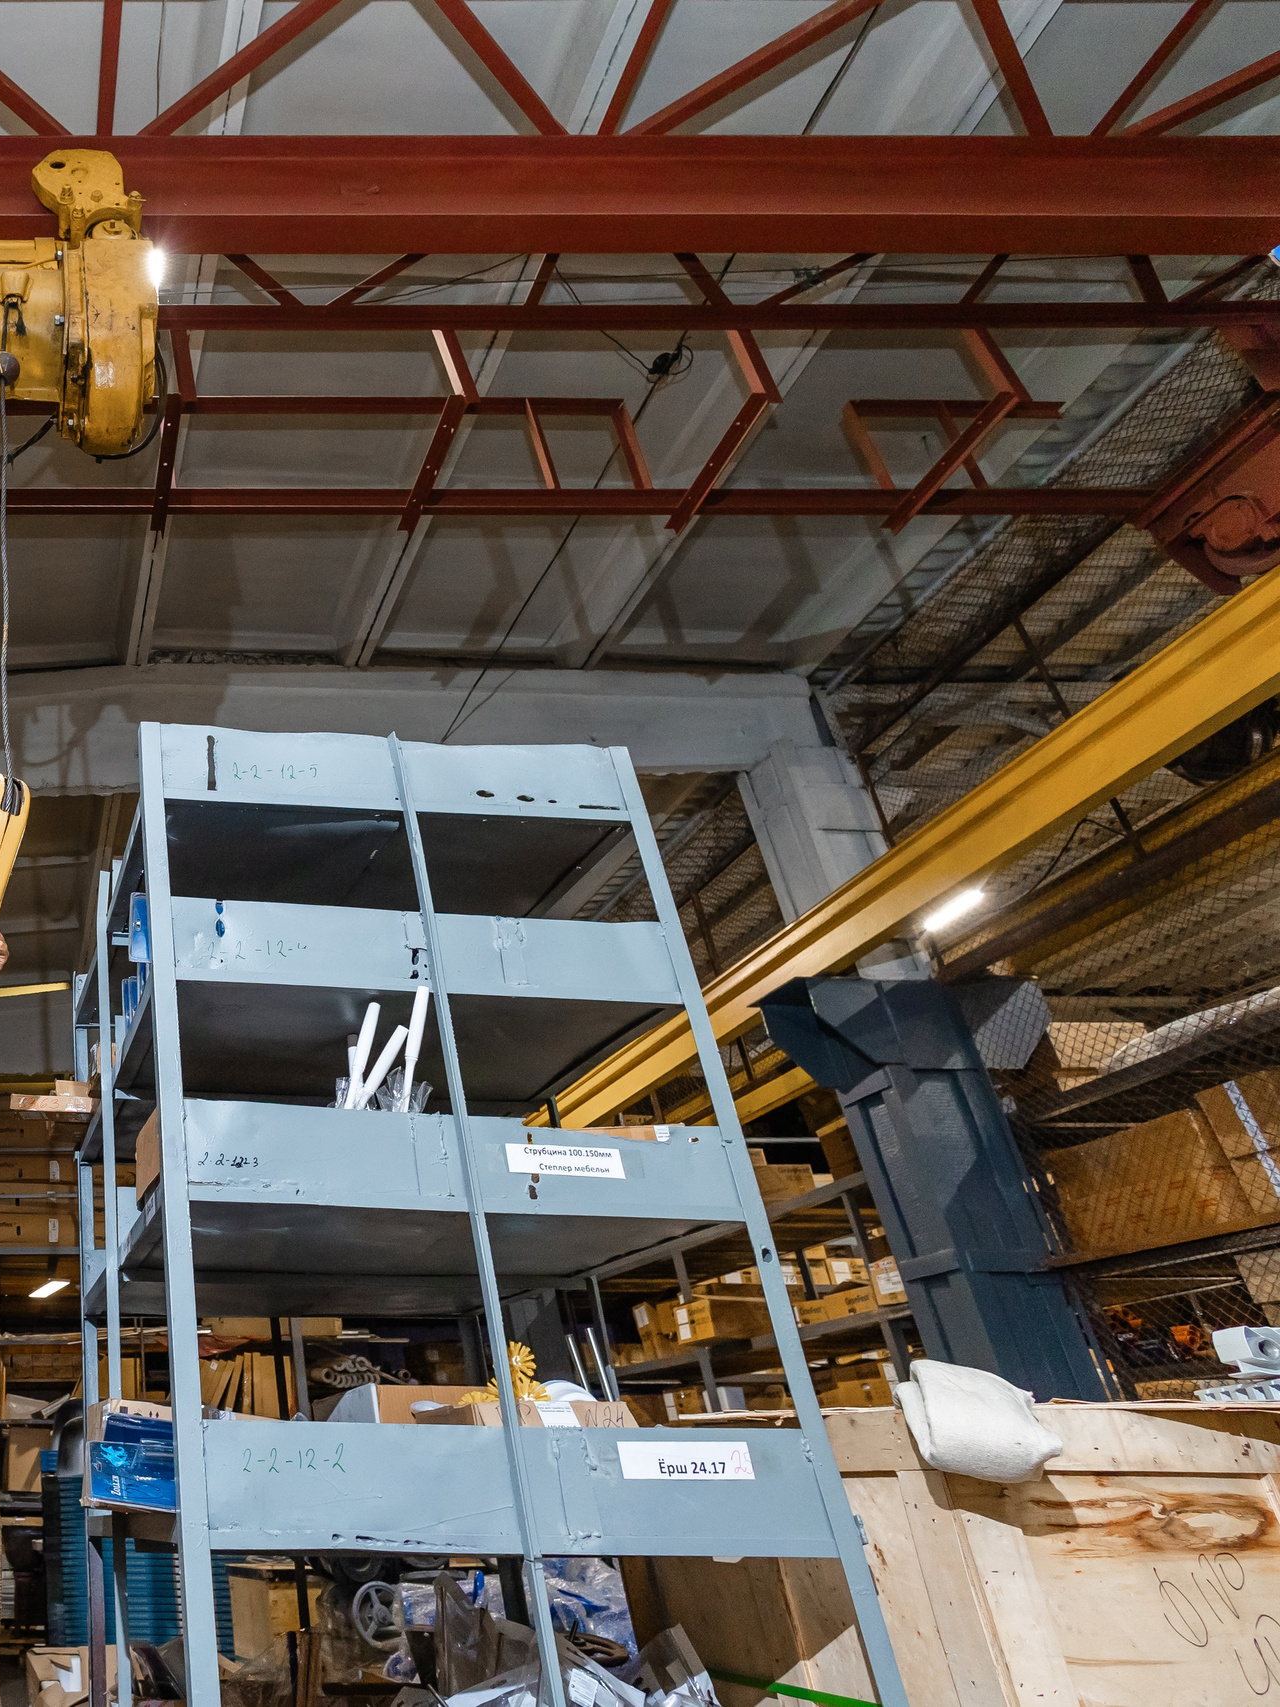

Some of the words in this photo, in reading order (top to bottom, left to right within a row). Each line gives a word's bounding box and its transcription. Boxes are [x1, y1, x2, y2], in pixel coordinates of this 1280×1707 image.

[523, 1147, 567, 1157] Струбцина
[568, 1149, 613, 1158] 100.150мм
[539, 1163, 573, 1173] Степлер
[574, 1164, 611, 1174] мебельн
[243, 1442, 346, 1473] 2-2-12-2
[658, 1458, 688, 1477] Ёрш
[690, 1462, 726, 1475] 24.17
